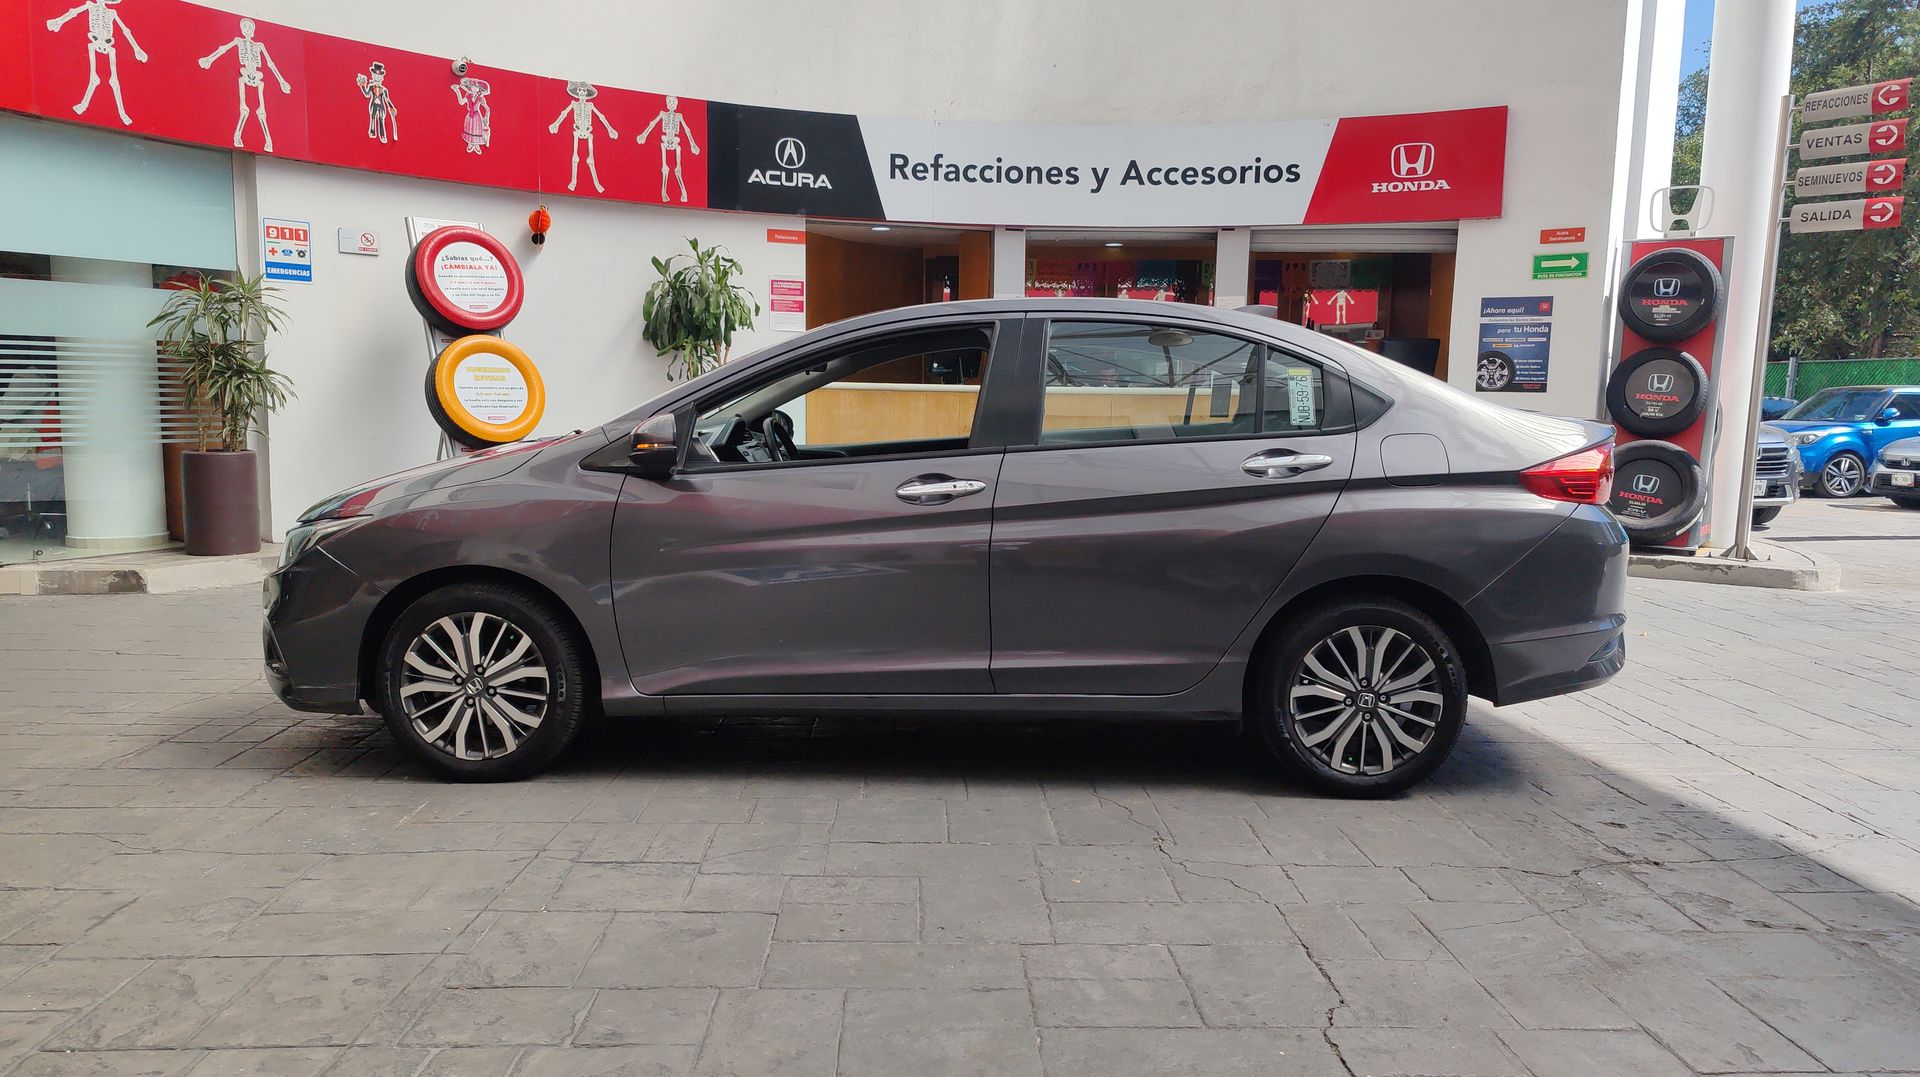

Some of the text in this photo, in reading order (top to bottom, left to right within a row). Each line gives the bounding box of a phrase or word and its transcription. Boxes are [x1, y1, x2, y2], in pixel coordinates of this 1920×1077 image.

[1805, 93, 1868, 112] REFACCIONES
[1806, 133, 1863, 149] VENTAS
[747, 168, 833, 190] ACURA
[889, 153, 1301, 194] Refacciones y Accesorios
[1797, 171, 1863, 187] SEMINUEVOS
[1371, 179, 1452, 193] HONDA
[1800, 209, 1852, 223] SALIDA
[268, 227, 305, 241] 911
[267, 267, 310, 277] EMERGENCIAS
[1641, 298, 1688, 306] HONDA
[1523, 325, 1549, 333] Honda
[1635, 393, 1679, 402] HONDA
[1619, 491, 1663, 504] HONDA
